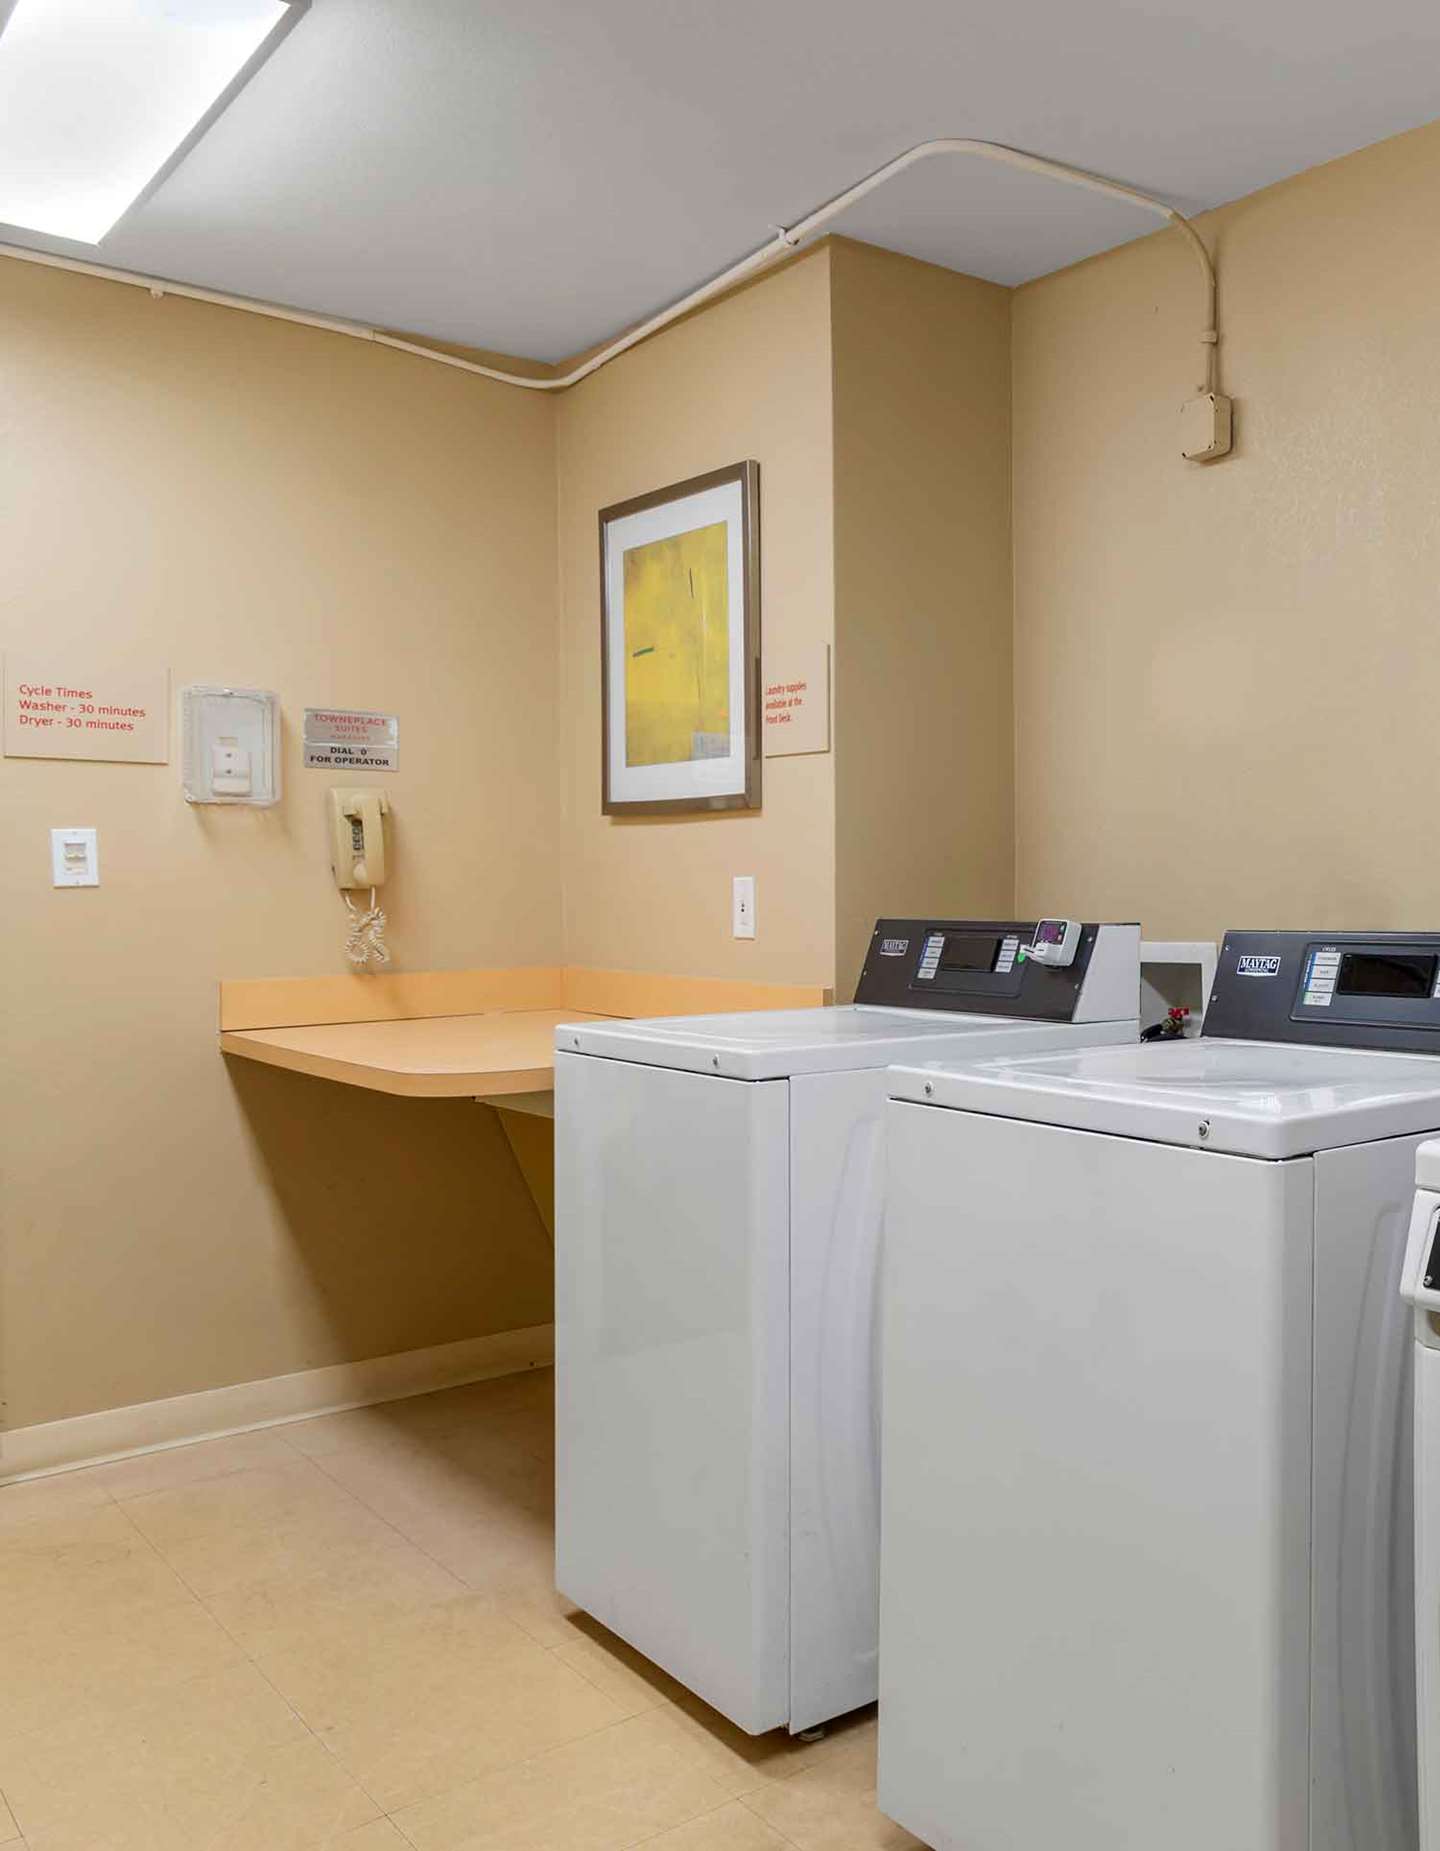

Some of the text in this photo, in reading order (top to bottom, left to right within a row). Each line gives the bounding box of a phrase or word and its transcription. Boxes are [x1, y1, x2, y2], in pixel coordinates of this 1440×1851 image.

[19, 684, 93, 699] Cycle Times
[19, 700, 67, 712] Washer
[79, 704, 94, 714] 30
[98, 705, 146, 717] minutes
[19, 715, 53, 727] Dryer
[66, 719, 82, 728] 30
[86, 720, 134, 731] minutes
[330, 746, 353, 755] DIAL
[310, 756, 390, 766] FOR OPERATOR
[1240, 958, 1277, 970] MAYTAG
